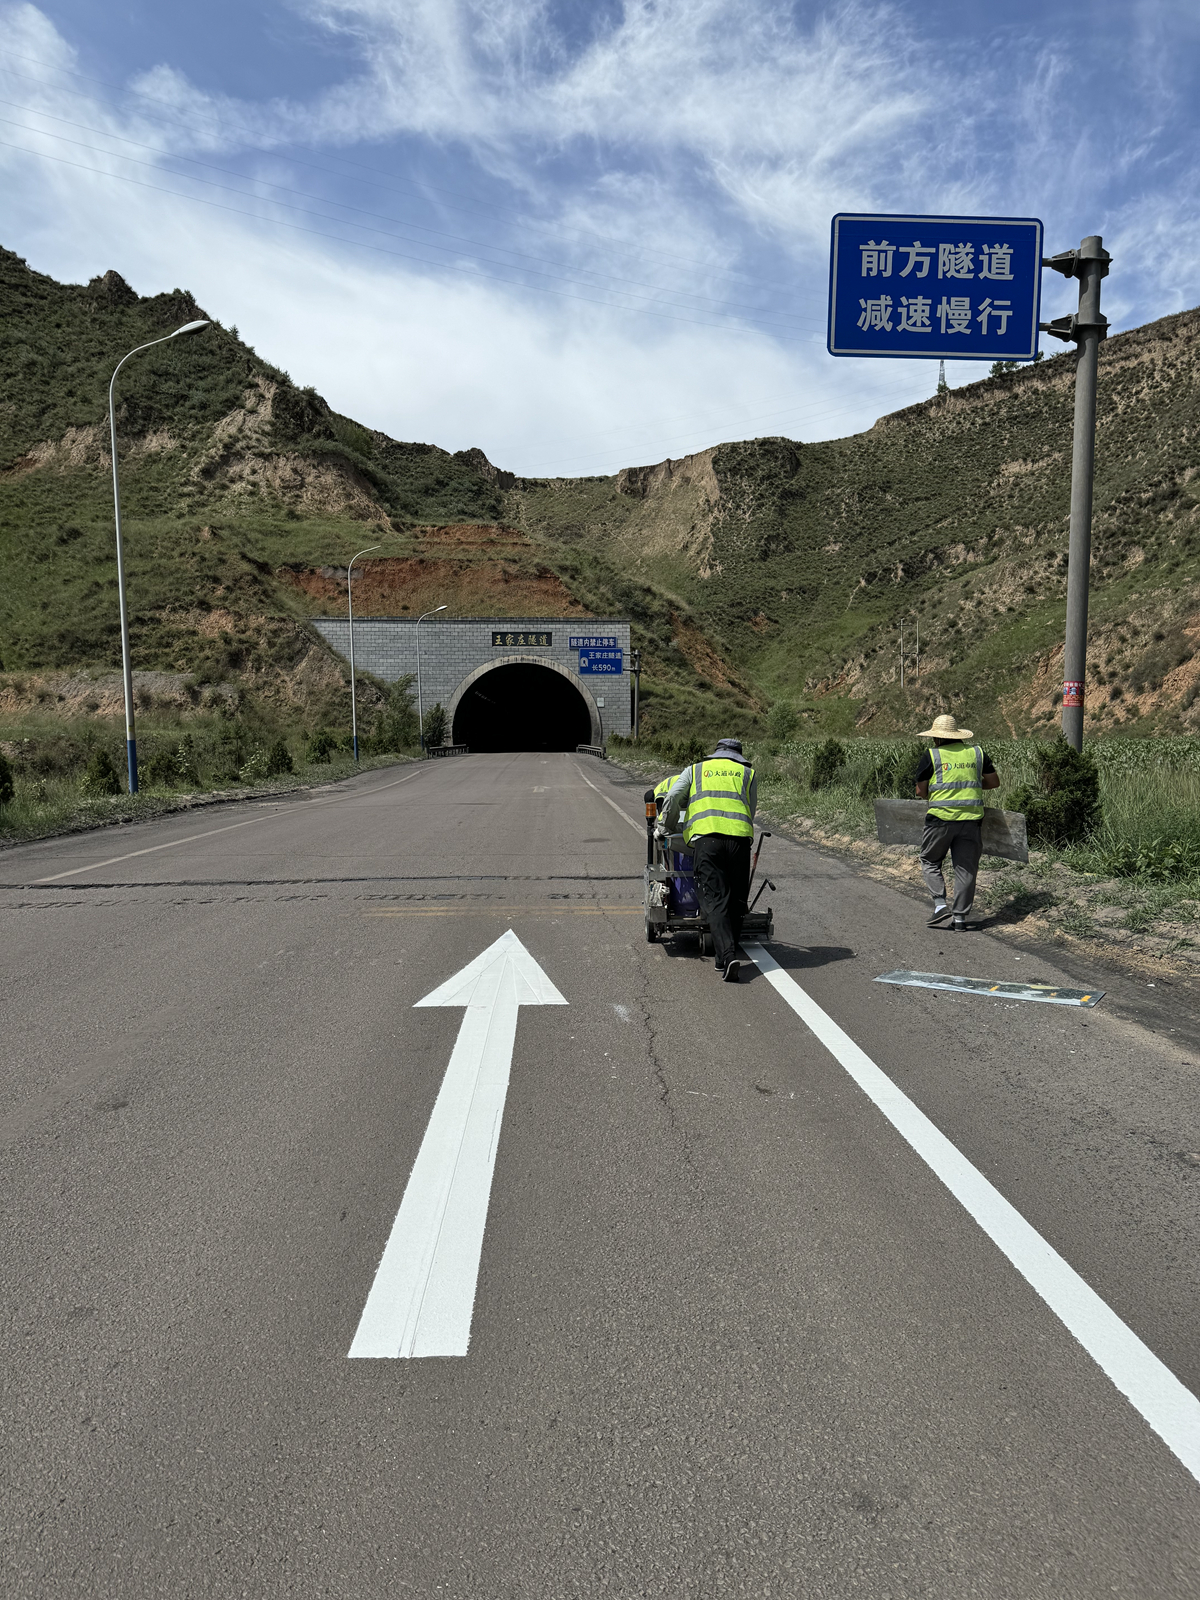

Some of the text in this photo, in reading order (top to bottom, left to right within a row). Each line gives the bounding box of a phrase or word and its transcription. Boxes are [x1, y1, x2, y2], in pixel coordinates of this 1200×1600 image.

[859, 239, 1014, 281] 前方隧道
[856, 294, 1013, 336] 减速慢行
[494, 634, 549, 646] 王家庄隧道
[570, 638, 615, 647] 隧道内禁止停车
[589, 651, 621, 659] 王家庄隧道
